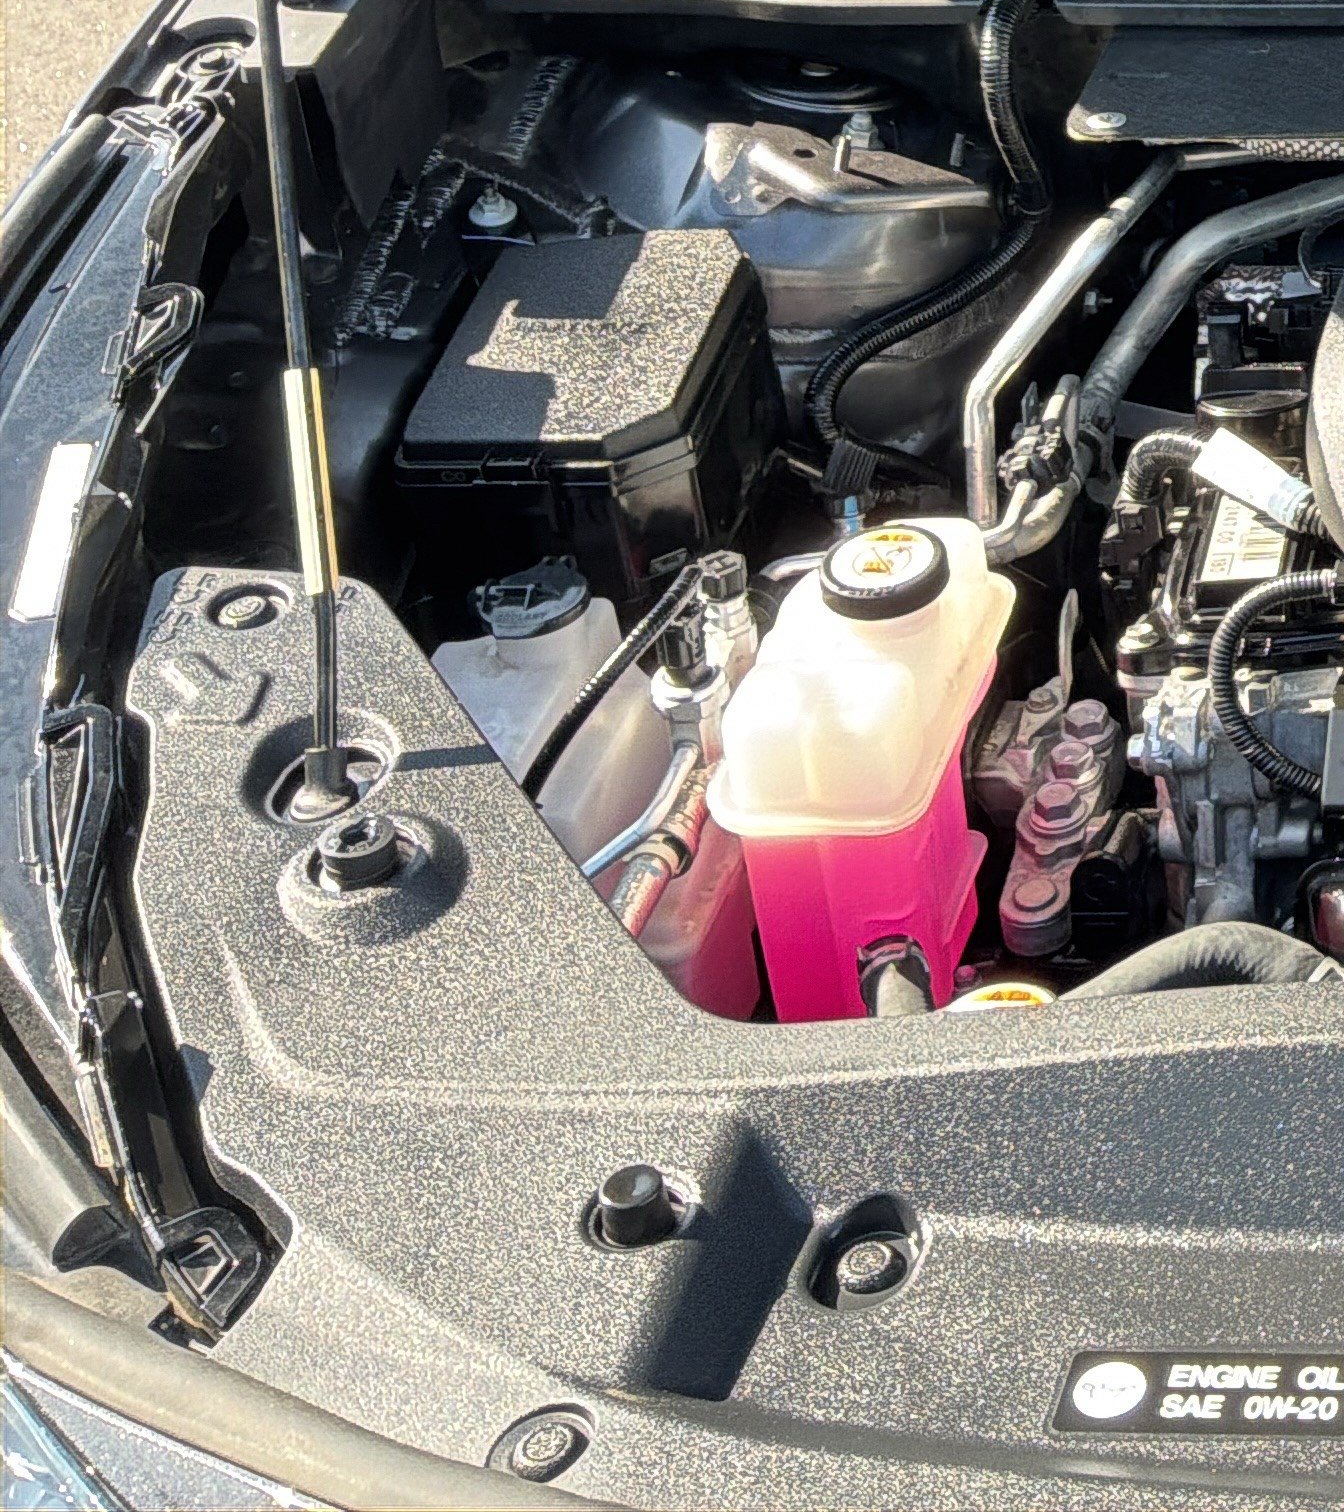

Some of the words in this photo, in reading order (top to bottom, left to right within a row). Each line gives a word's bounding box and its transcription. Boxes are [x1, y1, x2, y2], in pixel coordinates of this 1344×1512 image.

[1166, 1364, 1283, 1390] ENGINE
[1159, 1394, 1226, 1419] SAE
[1242, 1395, 1340, 1421] 0W-20
